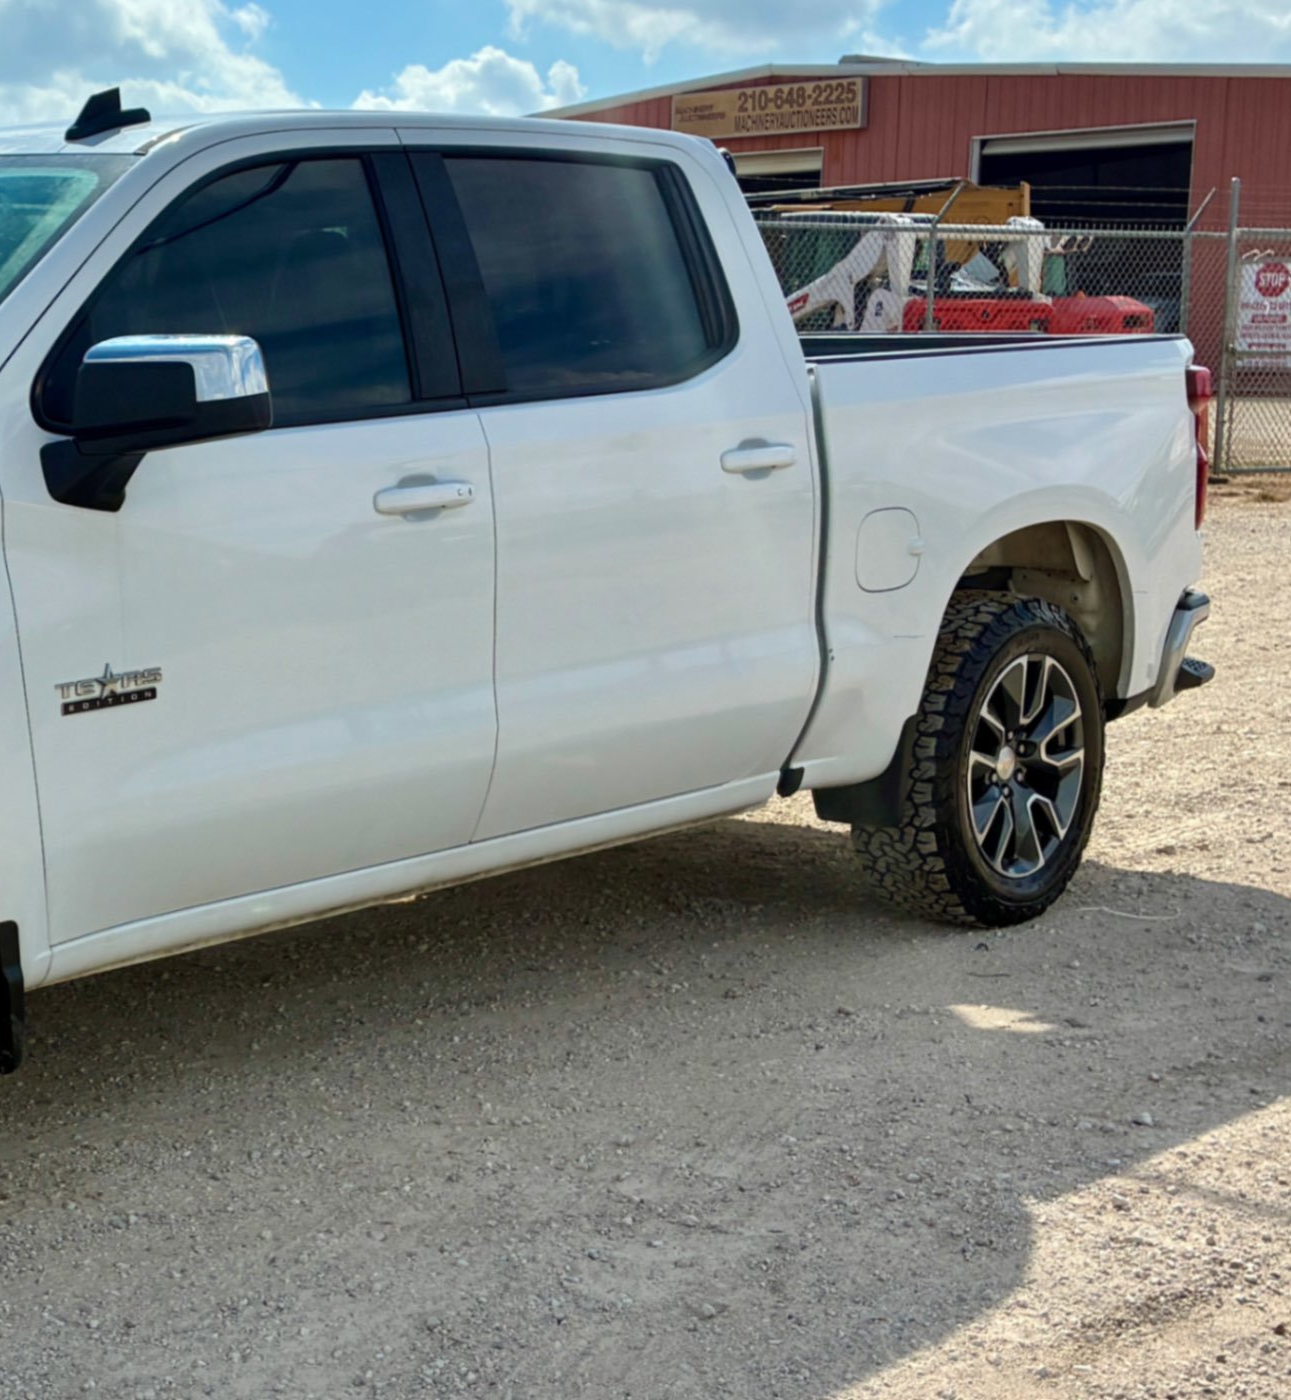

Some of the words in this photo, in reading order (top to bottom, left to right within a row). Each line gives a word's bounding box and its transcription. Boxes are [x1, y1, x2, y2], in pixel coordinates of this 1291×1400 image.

[737, 82, 857, 113] 210-648-2225
[734, 105, 859, 132] MACHINERYAUCTIONEERS.COM
[1260, 273, 1286, 288] STOP
[68, 691, 152, 711] EDITION
